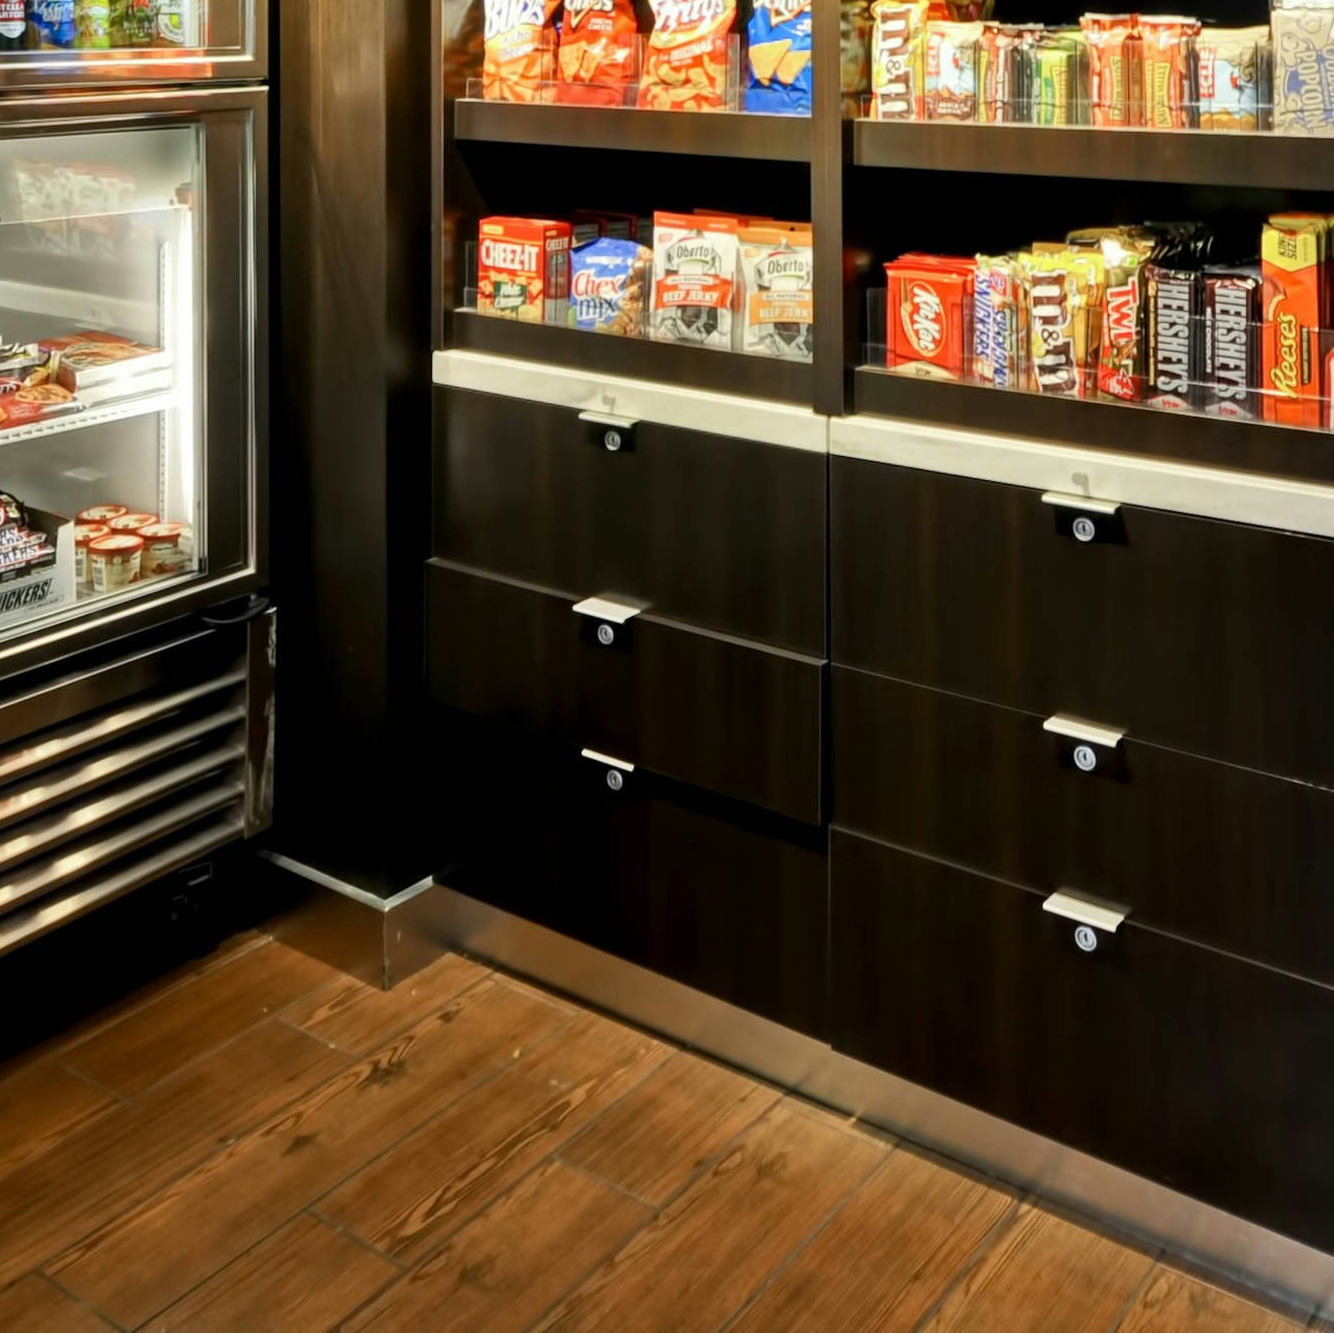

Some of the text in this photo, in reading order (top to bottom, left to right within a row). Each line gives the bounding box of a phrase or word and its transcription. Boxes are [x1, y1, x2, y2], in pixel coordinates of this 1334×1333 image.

[1295, 49, 1326, 129] POPCORN
[481, 238, 540, 272] CHEEZ-IT
[676, 244, 710, 259] Oberto
[572, 269, 621, 297] Chex
[767, 260, 804, 275] Oberto
[578, 296, 617, 320] mix
[975, 273, 991, 362] SNICKERS
[1270, 311, 1300, 400] Reese's
